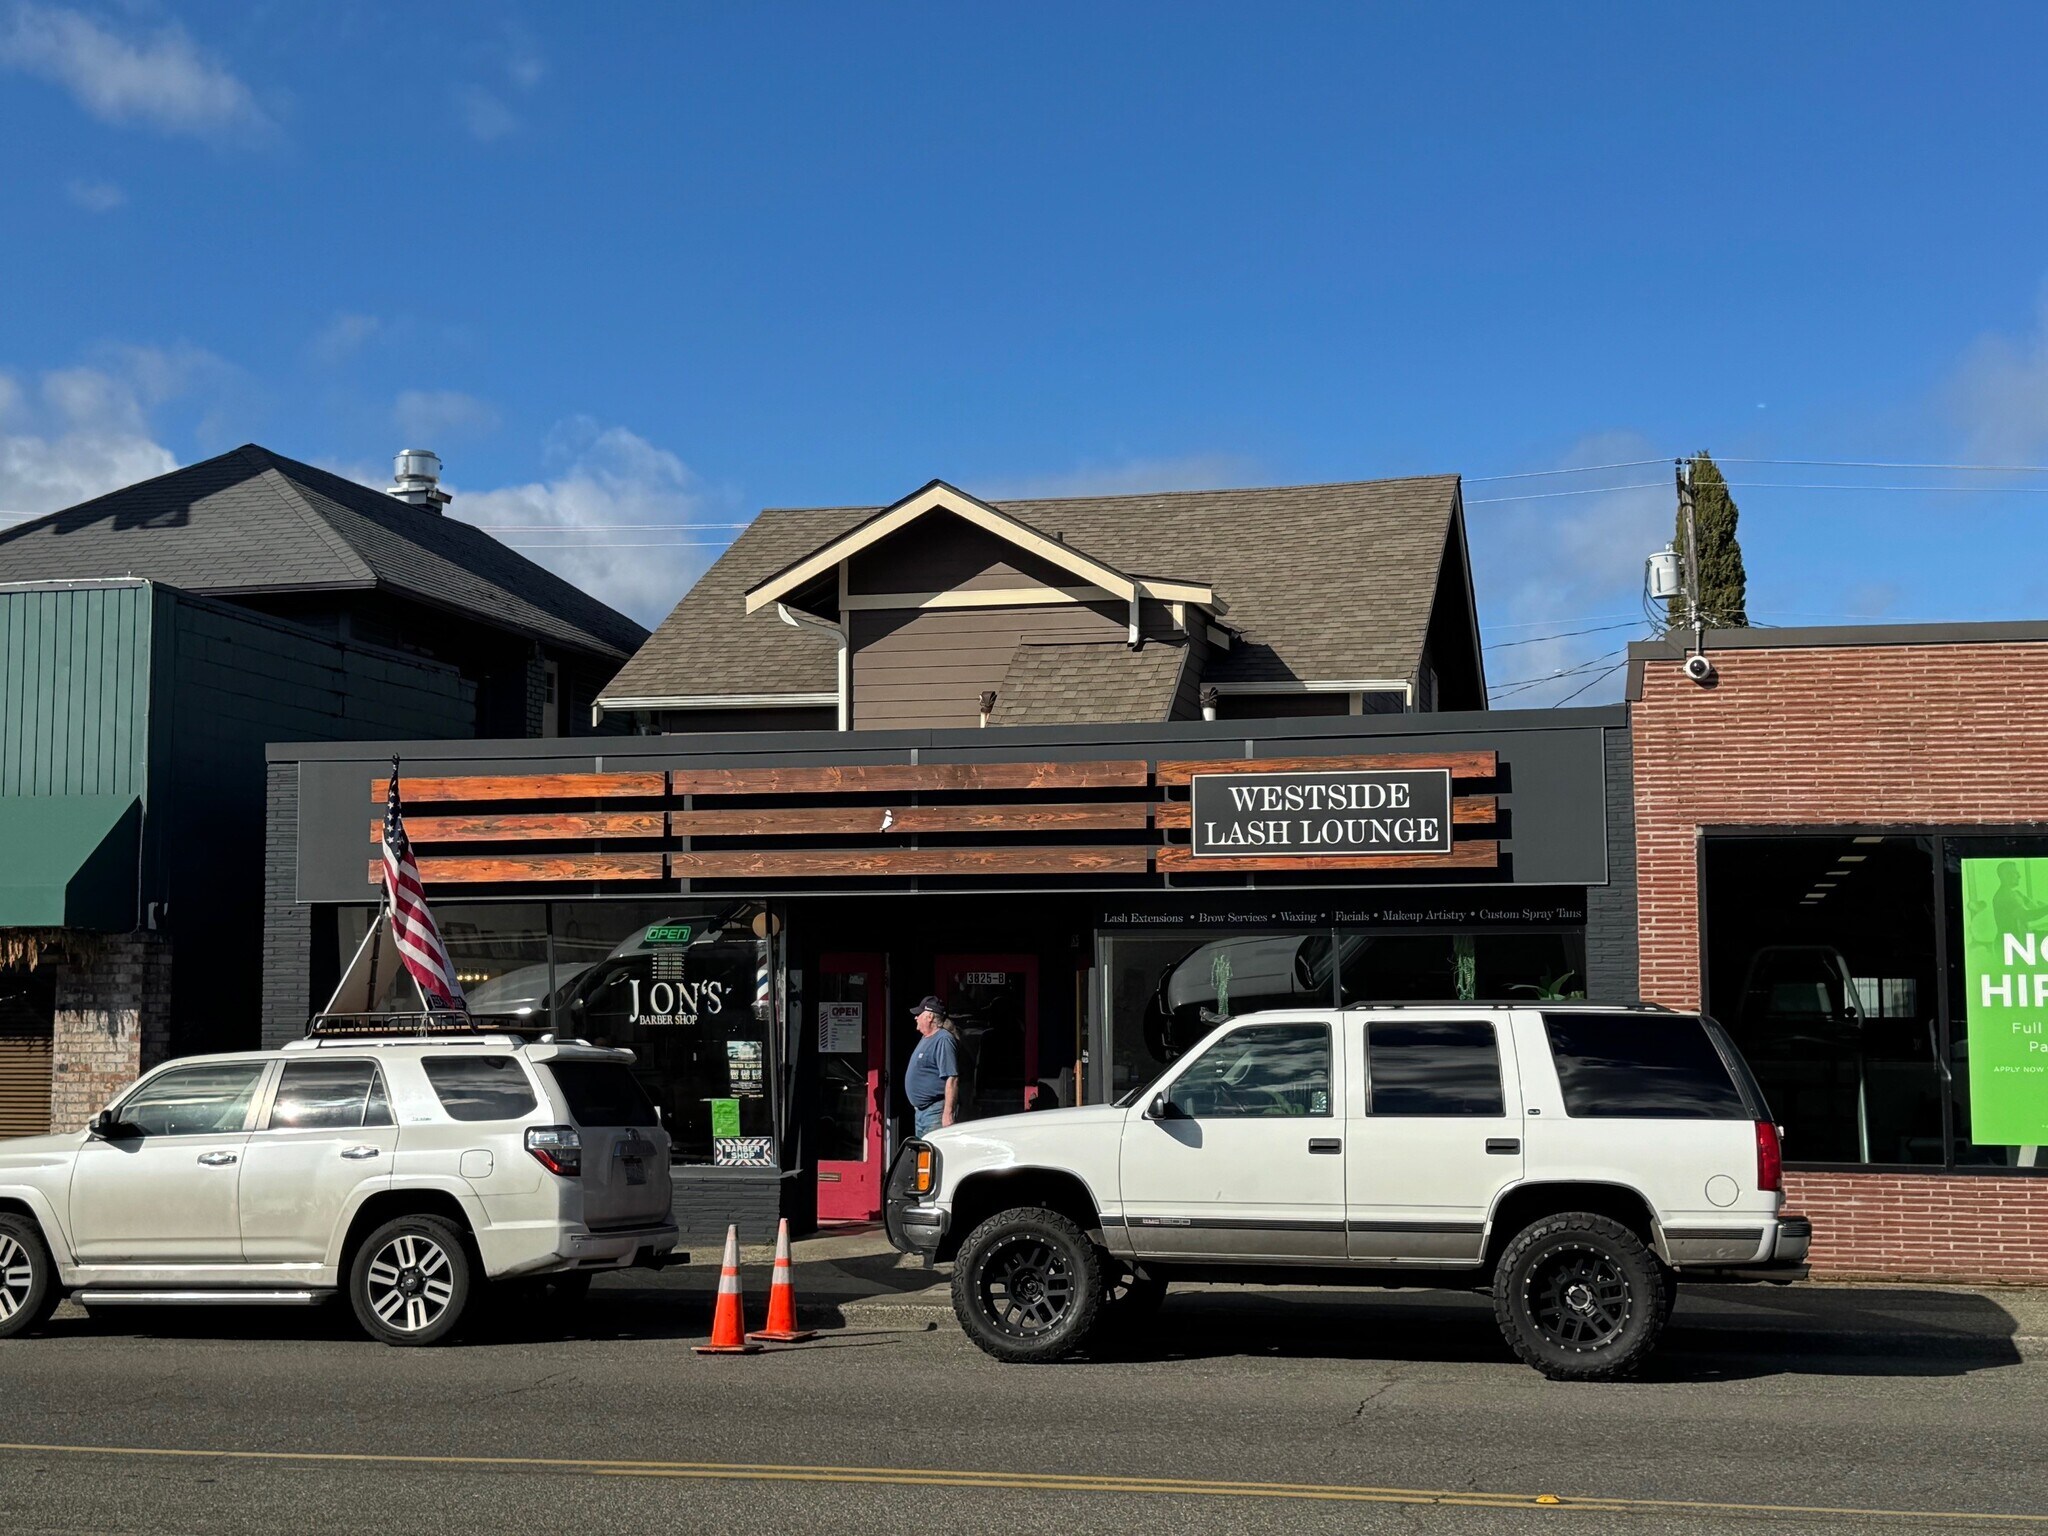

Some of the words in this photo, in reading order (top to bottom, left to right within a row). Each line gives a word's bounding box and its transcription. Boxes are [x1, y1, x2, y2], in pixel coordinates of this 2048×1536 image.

[1228, 783, 1410, 811] WESTSIDE
[1204, 820, 1291, 845] LASH
[1300, 817, 1439, 844] LOUNGE
[1104, 913, 1128, 922] Lash
[1130, 913, 1184, 922] Extensions
[1199, 913, 1226, 922] Brow
[1228, 913, 1268, 922] Services
[1280, 912, 1317, 922] Waxing
[1335, 911, 1370, 921] Facials
[1383, 911, 1423, 922] Makeup
[1425, 910, 1467, 921] Artistry
[1479, 909, 1520, 919] Custom
[1522, 908, 1554, 921] Spray
[1556, 908, 1582, 918] Tans
[648, 929, 688, 939] OPEN
[2003, 933, 2048, 966] N
[629, 979, 722, 1022] JON'S
[832, 1007, 859, 1017] OPEN
[640, 1014, 674, 1025] BARBER
[675, 1014, 698, 1025] SHOP
[2012, 1021, 2042, 1034] Full
[725, 1144, 760, 1152] BARBER
